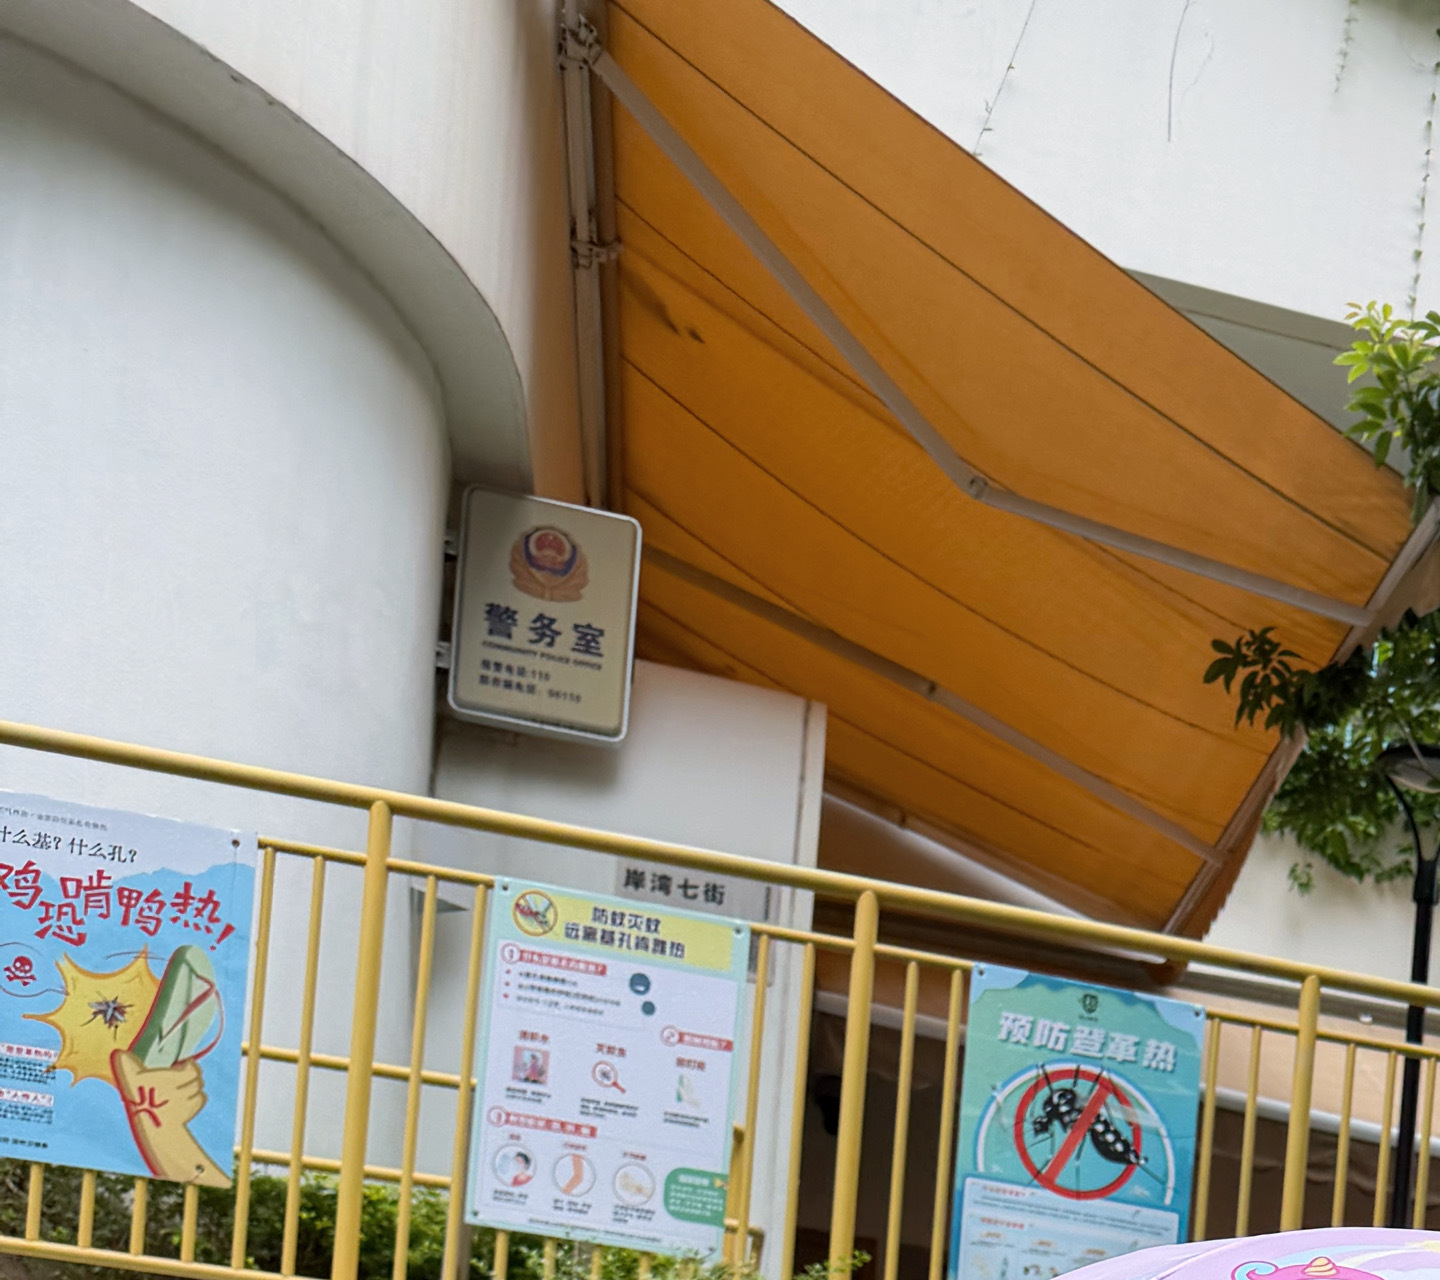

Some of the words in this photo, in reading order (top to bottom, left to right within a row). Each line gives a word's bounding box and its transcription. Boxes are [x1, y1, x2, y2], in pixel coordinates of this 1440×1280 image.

[485, 602, 605, 658] 警务室
[623, 868, 727, 906] 岸湾七街
[591, 907, 661, 934] 防蚊灭蚊
[998, 1011, 1177, 1073] 预防登革热
